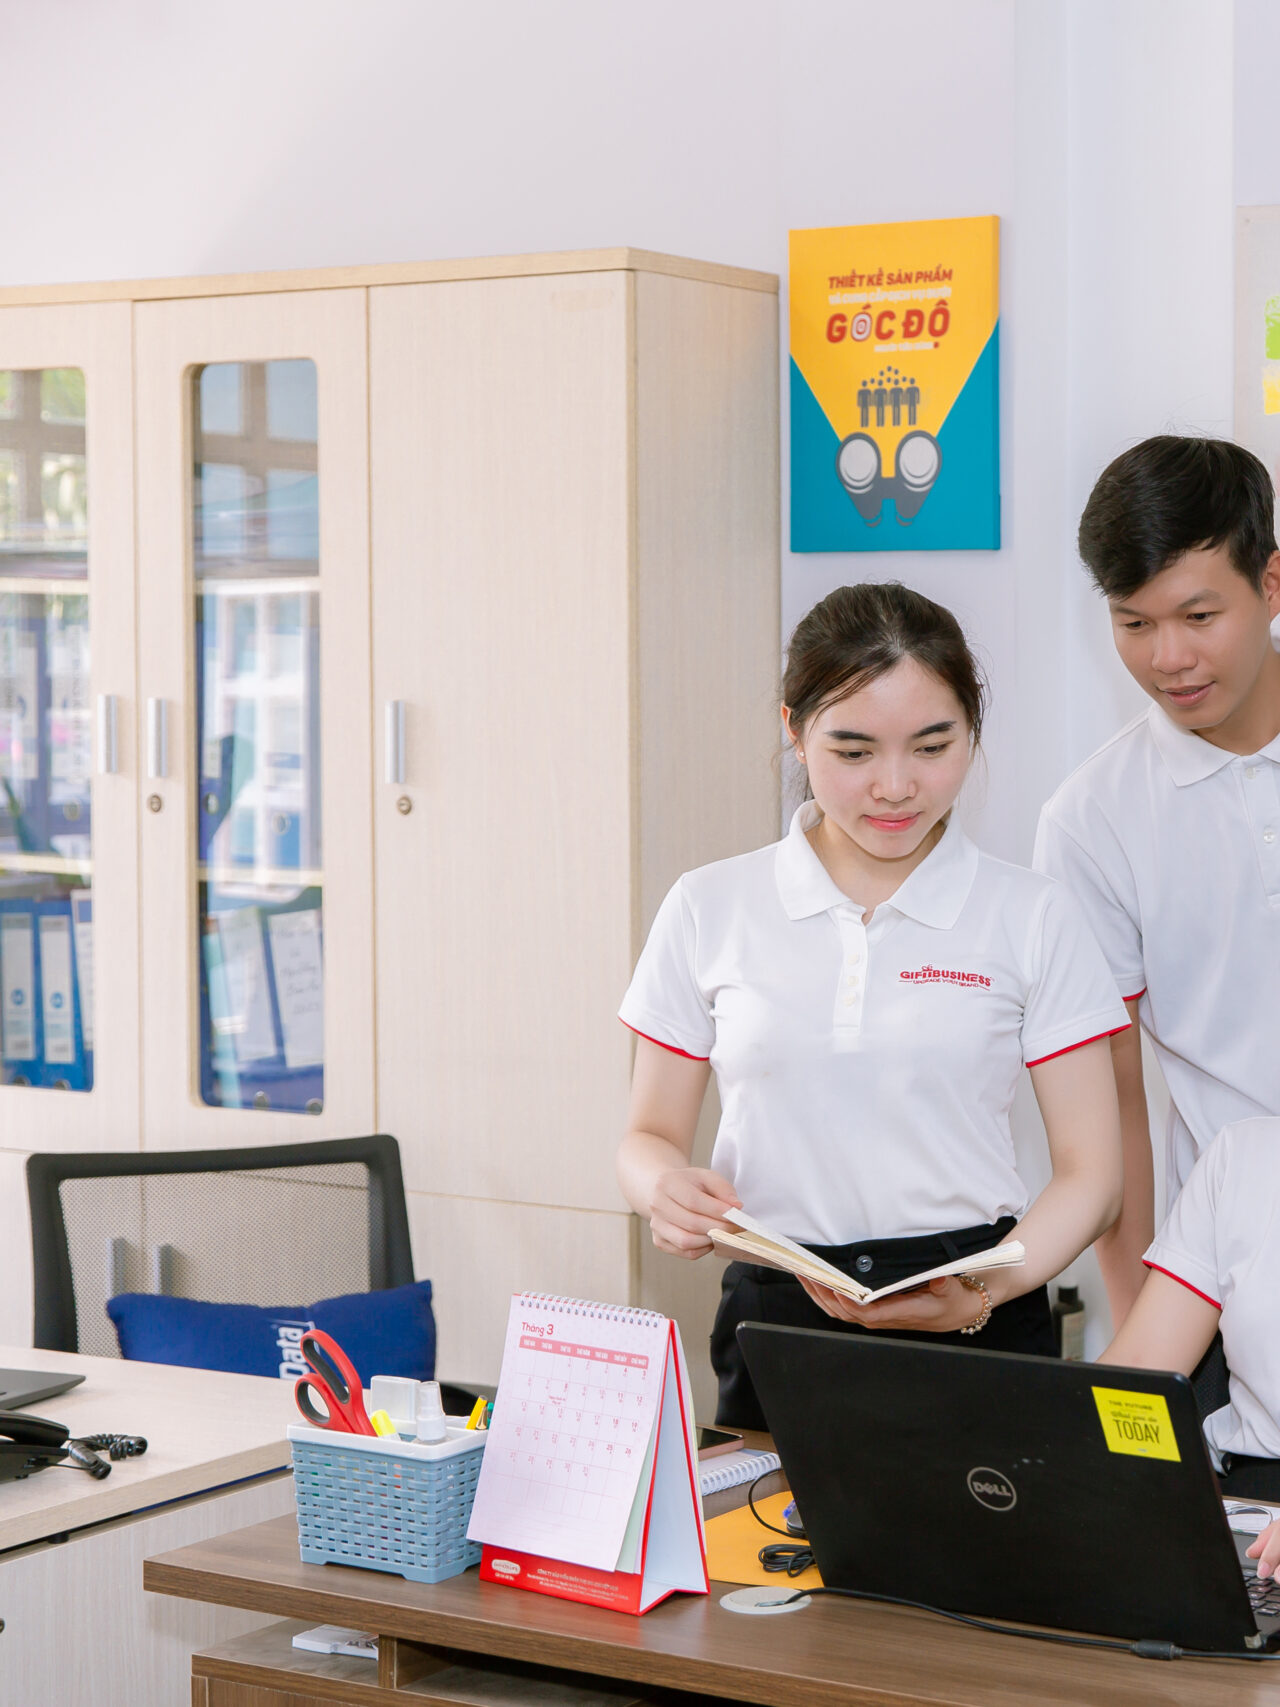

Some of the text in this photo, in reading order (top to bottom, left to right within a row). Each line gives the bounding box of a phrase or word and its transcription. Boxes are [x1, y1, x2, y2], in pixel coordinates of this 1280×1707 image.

[546, 1324, 554, 1335] 3
[1113, 1419, 1160, 1443] TODAY
[972, 1481, 1011, 1496] DELL
